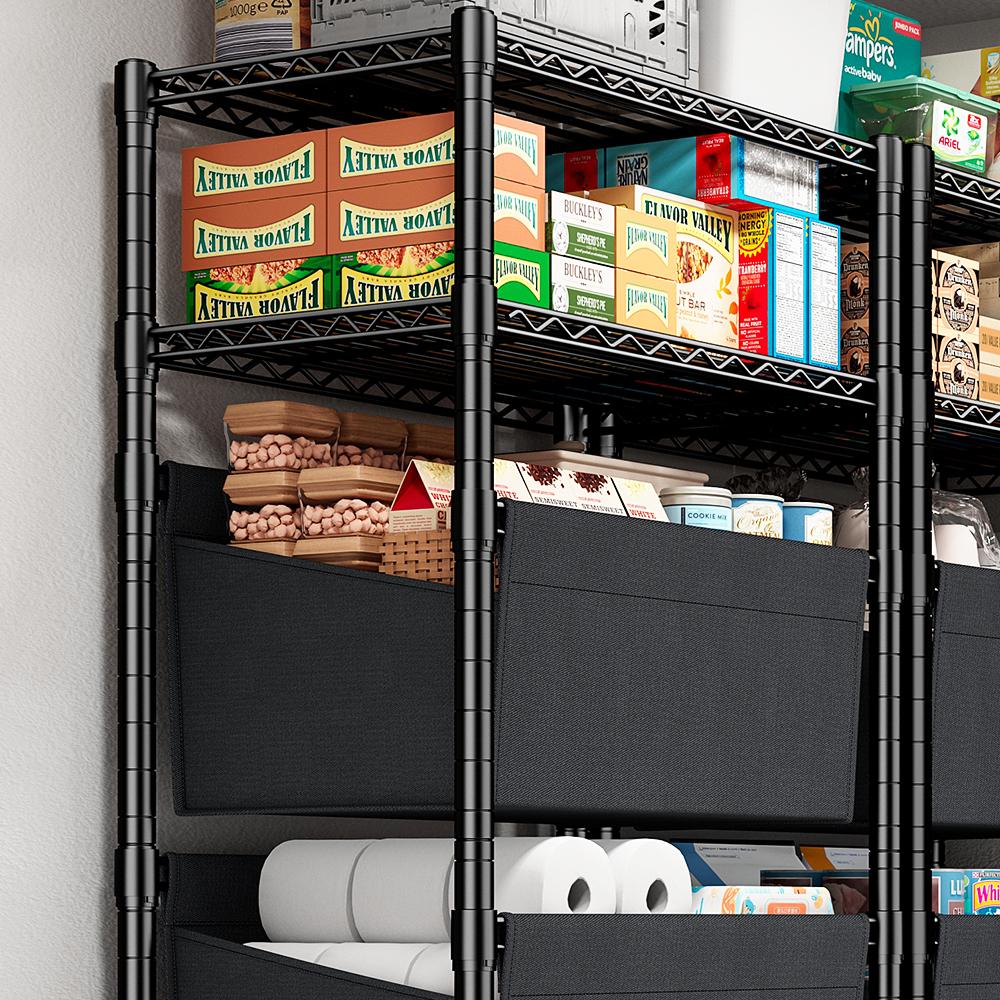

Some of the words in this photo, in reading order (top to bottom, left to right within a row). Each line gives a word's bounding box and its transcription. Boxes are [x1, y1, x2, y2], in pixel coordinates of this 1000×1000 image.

[845, 32, 895, 68] ampers
[254, 149, 311, 185] FLAVOR
[342, 145, 399, 174] VALLEY
[618, 156, 648, 172] GRAIN
[196, 165, 248, 193] VALLEY
[342, 209, 399, 238] VALLEY
[564, 199, 603, 222] BUCKLEY'S
[254, 212, 311, 248] FLAVOR
[692, 210, 732, 253] VALLEY
[738, 220, 767, 231] NERGY
[196, 228, 248, 255] VALLEY
[496, 258, 518, 285] FLAVOR
[518, 262, 540, 292] VALLEY
[564, 262, 603, 284] BUCKLEY'S
[258, 277, 320, 314] FLAVOR
[344, 276, 403, 305] VALLEY
[198, 292, 254, 321] VALLEY
[688, 298, 706, 312] BAR
[846, 298, 865, 312] Monk
[496, 490, 519, 500] HITE
[630, 509, 657, 520] WHITE
[688, 512, 716, 520] COOKIE
